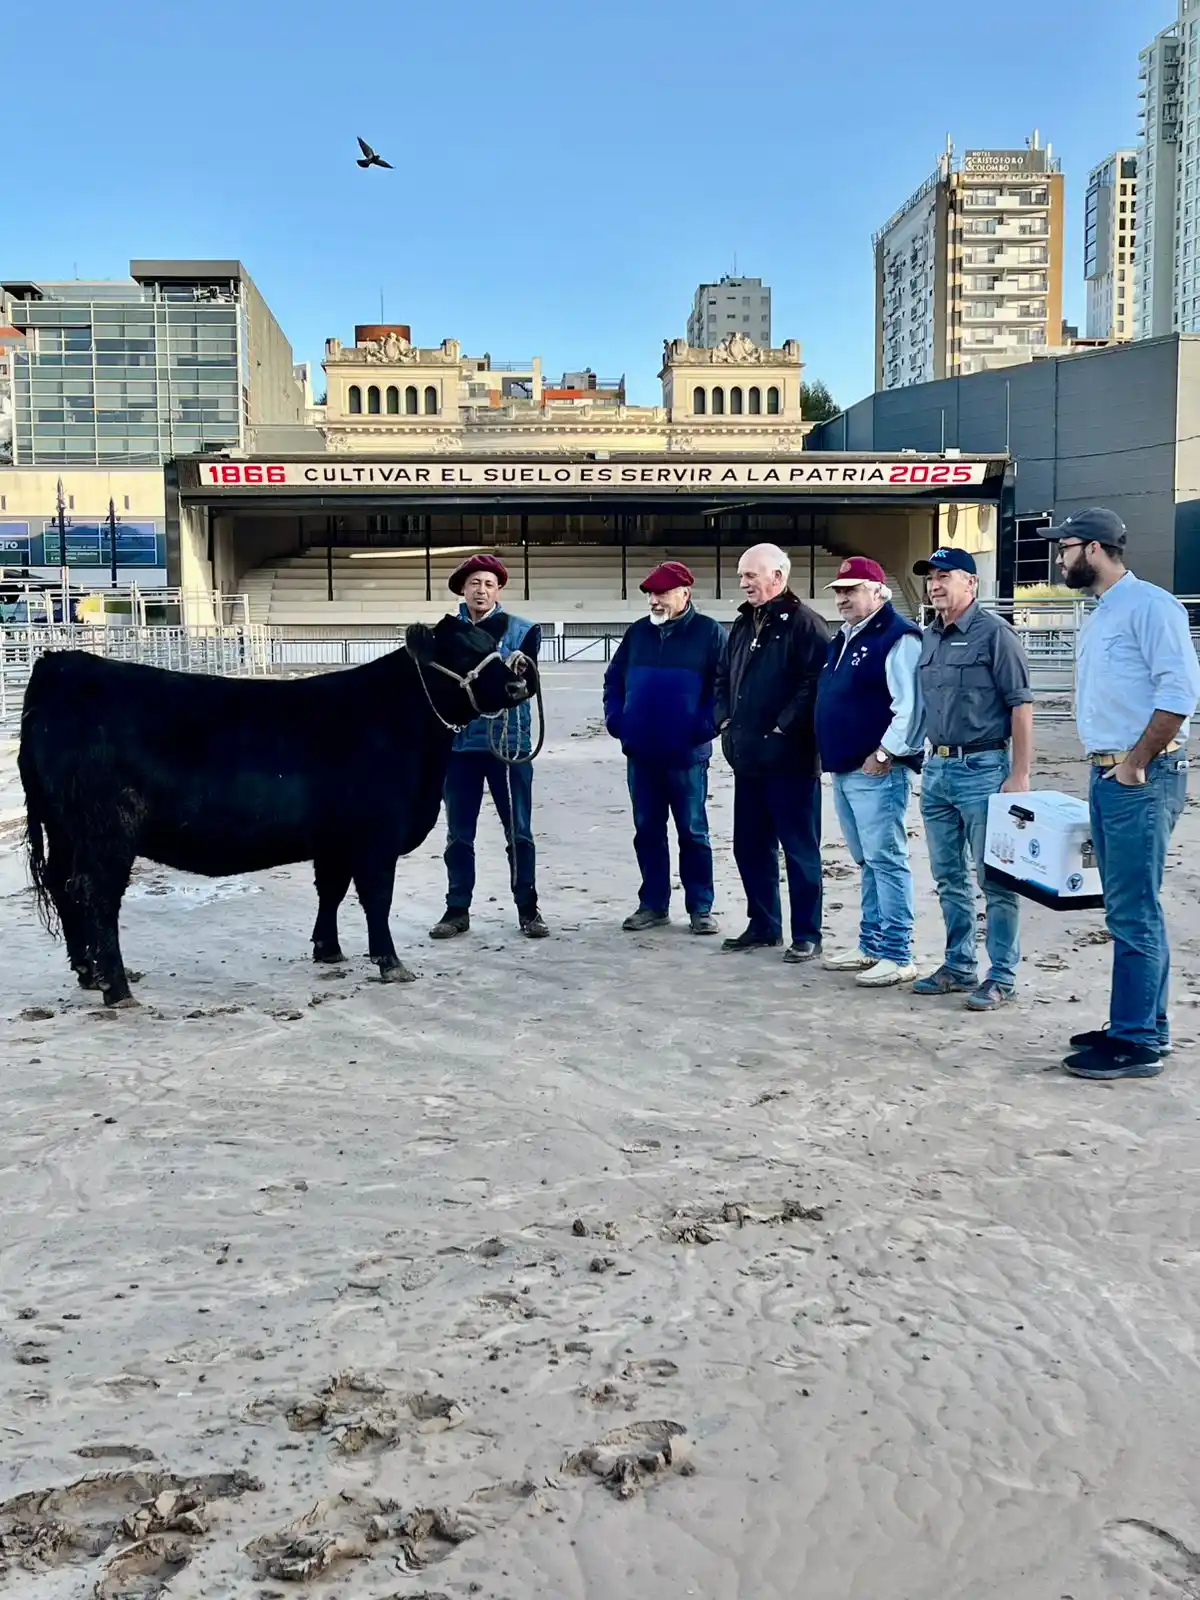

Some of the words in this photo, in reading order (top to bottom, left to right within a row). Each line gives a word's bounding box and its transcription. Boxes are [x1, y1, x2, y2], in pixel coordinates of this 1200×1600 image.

[208, 465, 287, 484] 1866
[304, 467, 430, 483] CULTIVAR
[441, 467, 473, 483] EL
[483, 467, 571, 483] SUELO
[580, 467, 613, 483] ES
[621, 467, 712, 483] SERVIR
[720, 467, 737, 483] A
[747, 467, 780, 483] LA
[789, 467, 884, 483] PATRIA
[888, 465, 973, 483] 2025
